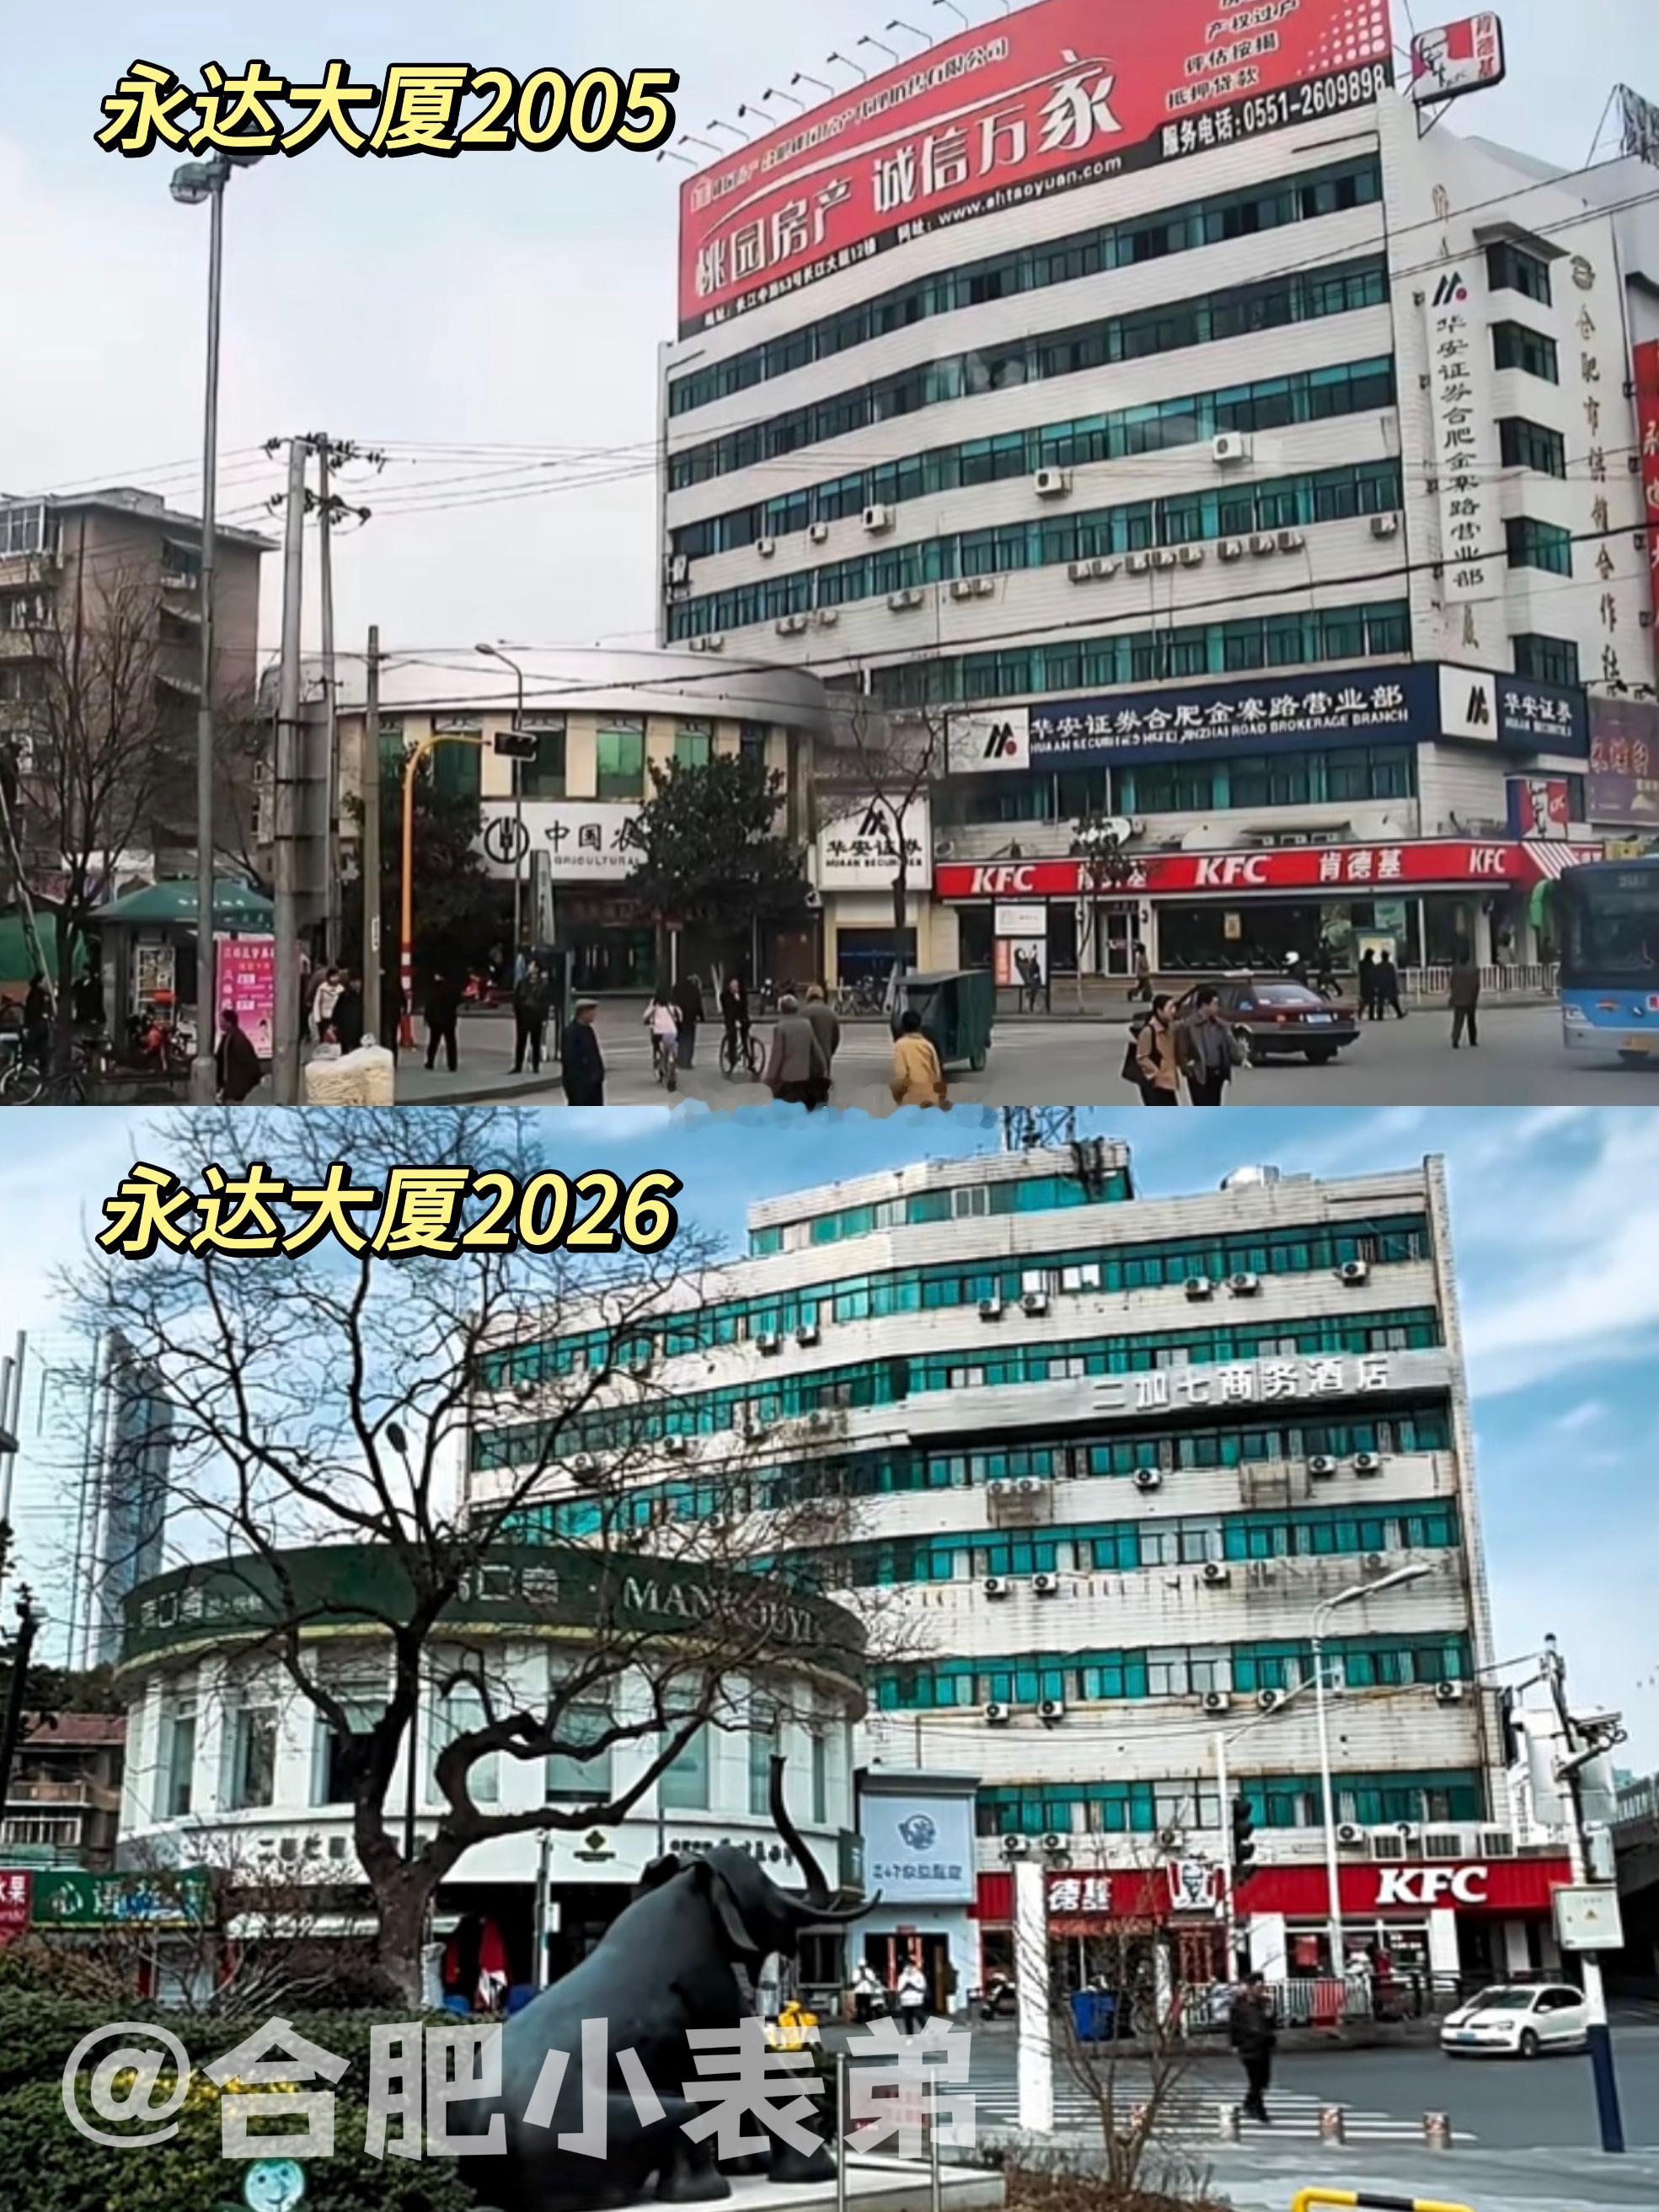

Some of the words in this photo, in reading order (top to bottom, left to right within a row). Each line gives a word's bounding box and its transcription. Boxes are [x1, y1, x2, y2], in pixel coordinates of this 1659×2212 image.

[696, 178, 854, 297] 桃园房产
[872, 50, 1123, 213] 诚信万家
[1030, 684, 1404, 740] 华安证券合肥金寨路营业部
[1232, 723, 1266, 738] ROAD
[1352, 709, 1409, 727] BRANCH
[1195, 855, 1272, 885] KFC
[1319, 849, 1403, 883] 肯德基
[1469, 847, 1507, 874] KFC
[971, 865, 1037, 894] KFC
[1093, 1357, 1389, 1412] 二加七商务酒店
[1048, 1876, 1113, 1911] 德基
[1375, 1867, 1488, 1905] KFC
